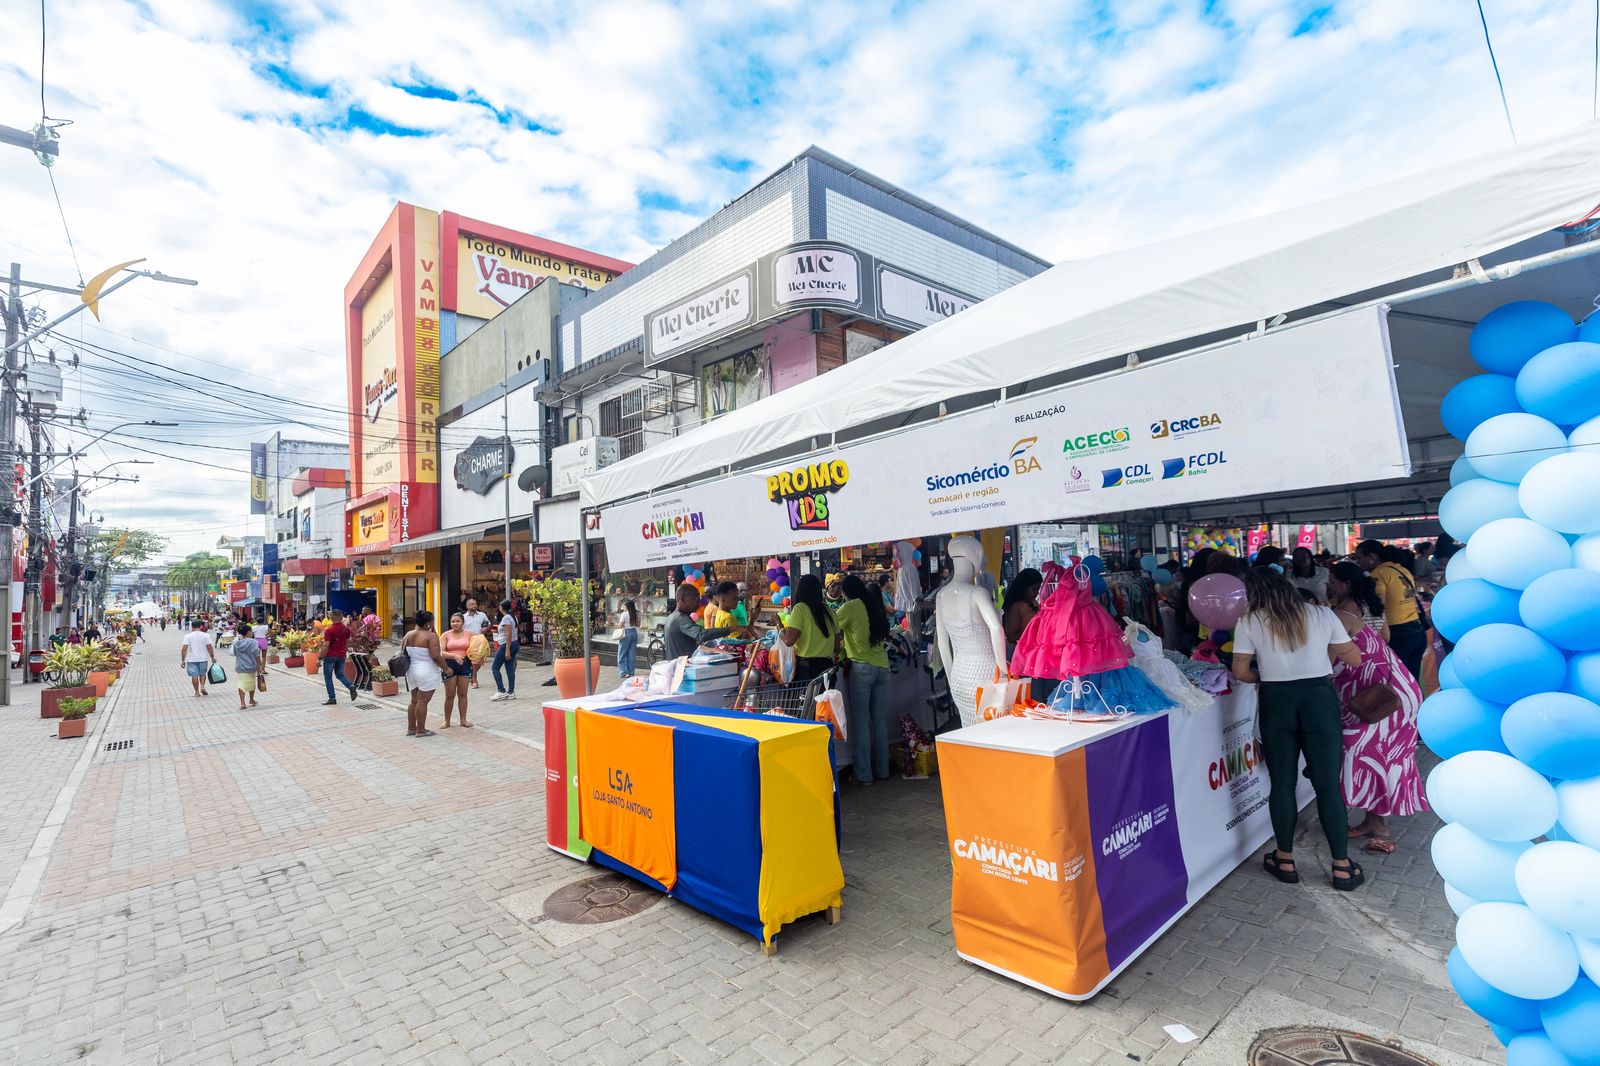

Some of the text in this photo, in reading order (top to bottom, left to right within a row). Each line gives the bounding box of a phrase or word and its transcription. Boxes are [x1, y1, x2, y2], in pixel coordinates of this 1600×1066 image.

[465, 236, 506, 257] Todo
[510, 248, 561, 271] Mundo
[566, 262, 600, 281] Trata
[1014, 405, 1066, 423] REALIZAÇÃO
[1170, 413, 1222, 432] CRCBA
[471, 449, 503, 474] CHARME
[1189, 451, 1227, 468] FCDL
[926, 456, 1042, 491] Sicomércio BA
[1124, 464, 1152, 478] CDL
[1126, 476, 1154, 485] Camaçari
[1188, 468, 1207, 476] Bahia
[255, 480, 263, 499] Center
[766, 459, 850, 503] PROMO
[928, 491, 963, 505] Camaçari
[972, 487, 999, 498] região
[652, 507, 691, 519] PREFEITURA
[930, 507, 951, 516] Sindicato
[960, 504, 981, 512] Sistema
[981, 500, 1006, 509] Comércio
[641, 512, 705, 540] CAMAÇARI
[792, 538, 815, 547] Comércio
[824, 535, 838, 544] Ação
[608, 768, 633, 795] LSA
[593, 789, 653, 820] LOJA SANTO ANTONIO
[1103, 811, 1153, 856] CAMAÇARI
[974, 835, 1037, 856] PREFEITURA
[953, 838, 1058, 882] CAMAÇARI
[981, 868, 1028, 885] COM NOSSA GENTE
